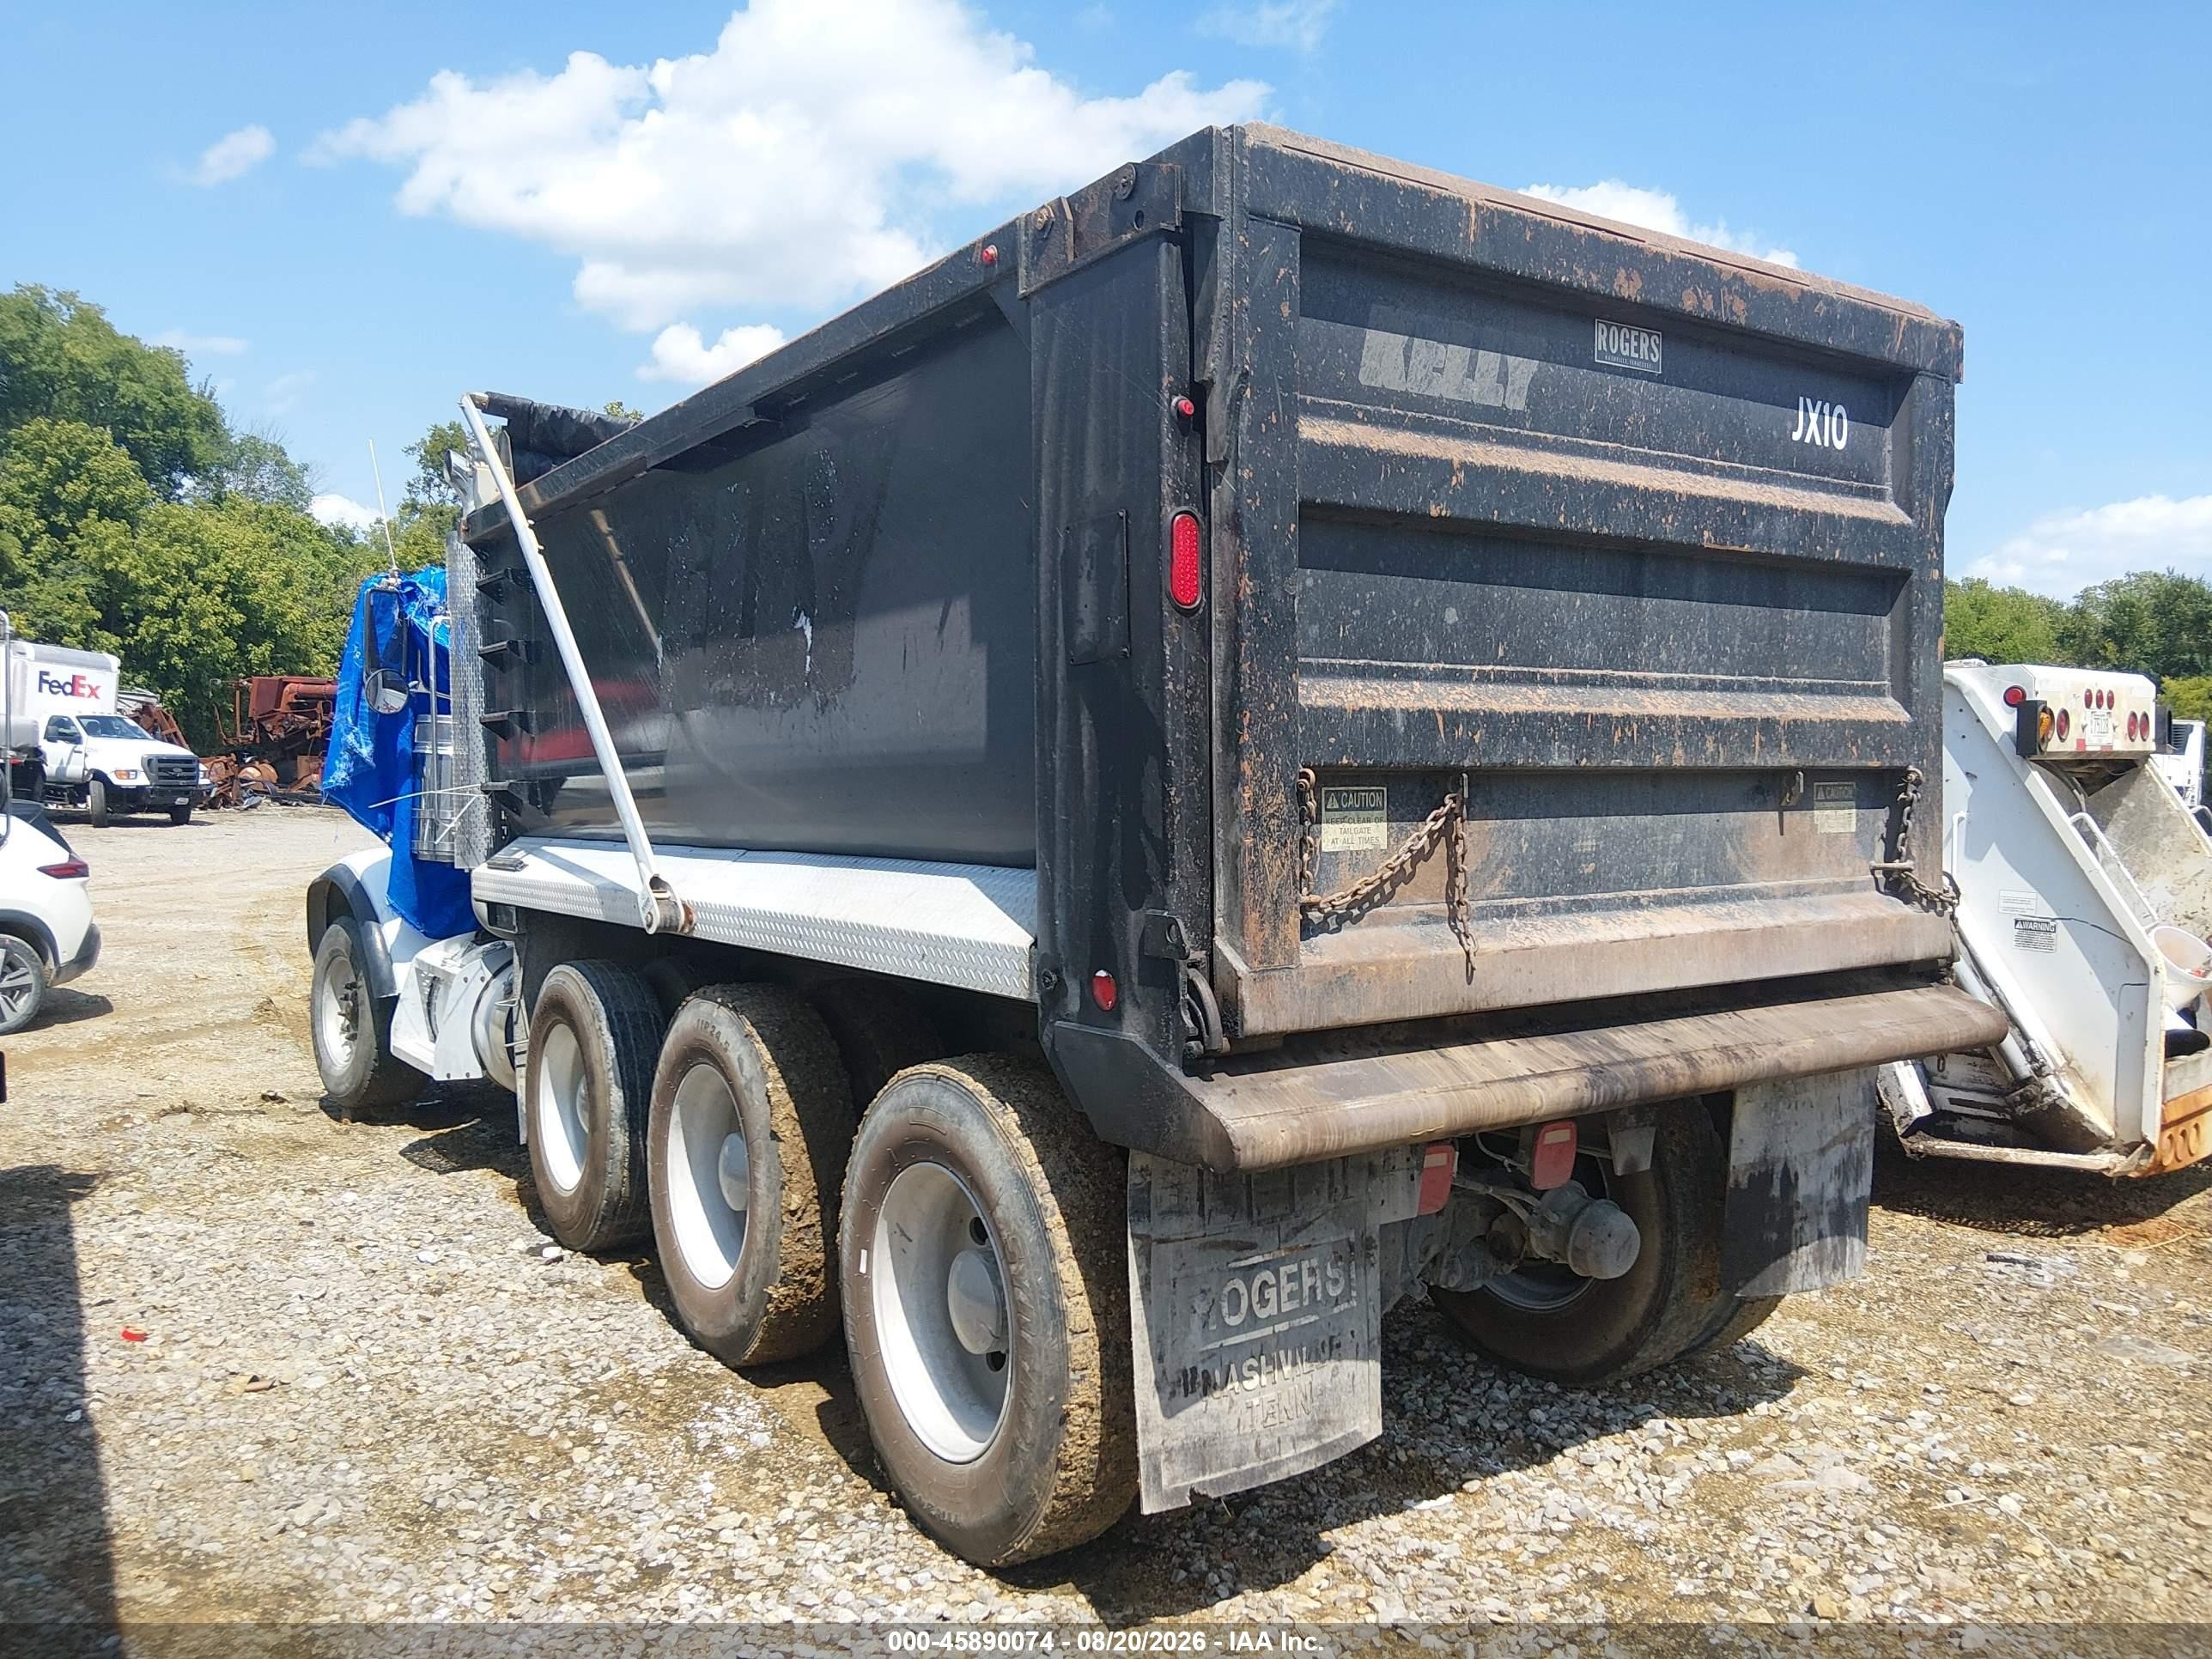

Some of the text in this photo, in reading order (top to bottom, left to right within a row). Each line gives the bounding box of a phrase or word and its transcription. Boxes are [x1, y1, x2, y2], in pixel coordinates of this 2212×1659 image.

[1597, 322, 1659, 363] ROGERS
[1791, 396, 1848, 451] JX10
[38, 670, 101, 700] FedEx
[1340, 792, 1382, 808] CAUTION
[1325, 816, 1346, 824] KEEP
[1342, 836, 1354, 845] ALL
[1358, 836, 1380, 845] TIMES
[2022, 920, 2056, 932] WARNING
